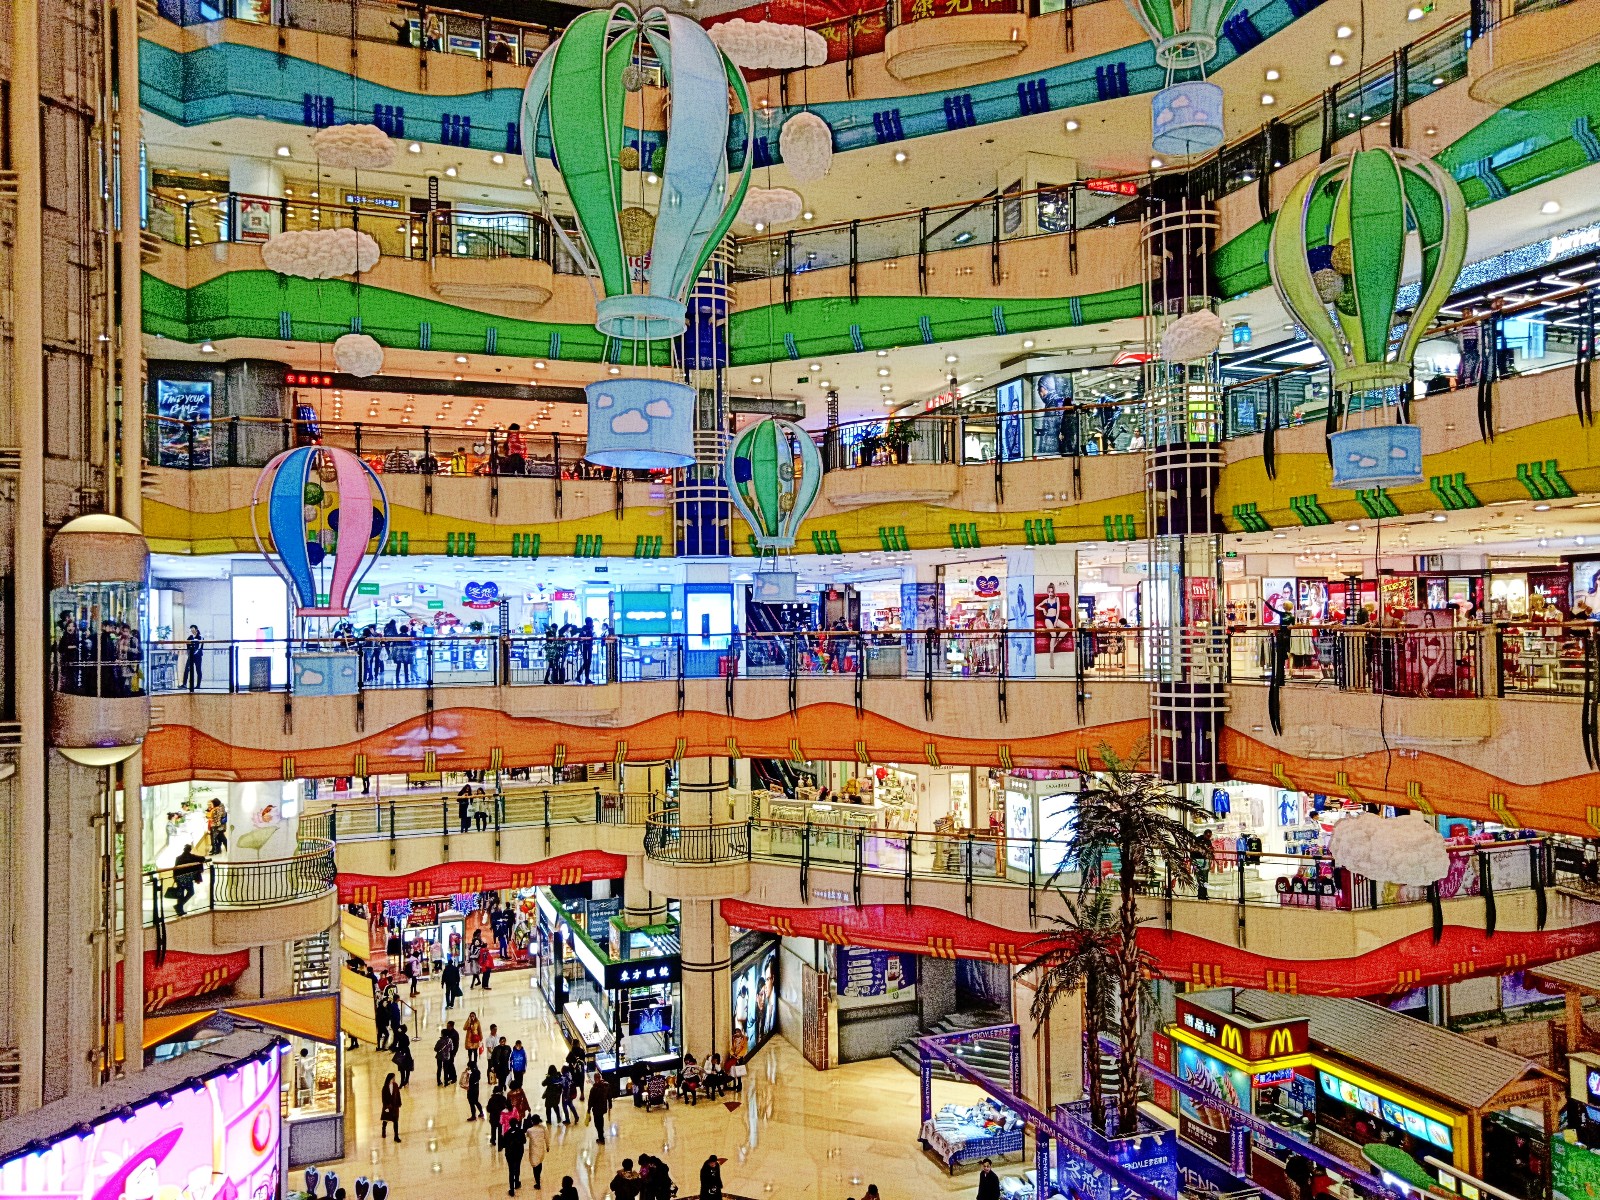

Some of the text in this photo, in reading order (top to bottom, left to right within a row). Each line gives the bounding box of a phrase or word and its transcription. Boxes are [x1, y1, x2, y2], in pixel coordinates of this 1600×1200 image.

[161, 392, 206, 406] FIND YOUR
[1183, 1012, 1217, 1038] 甜品站
